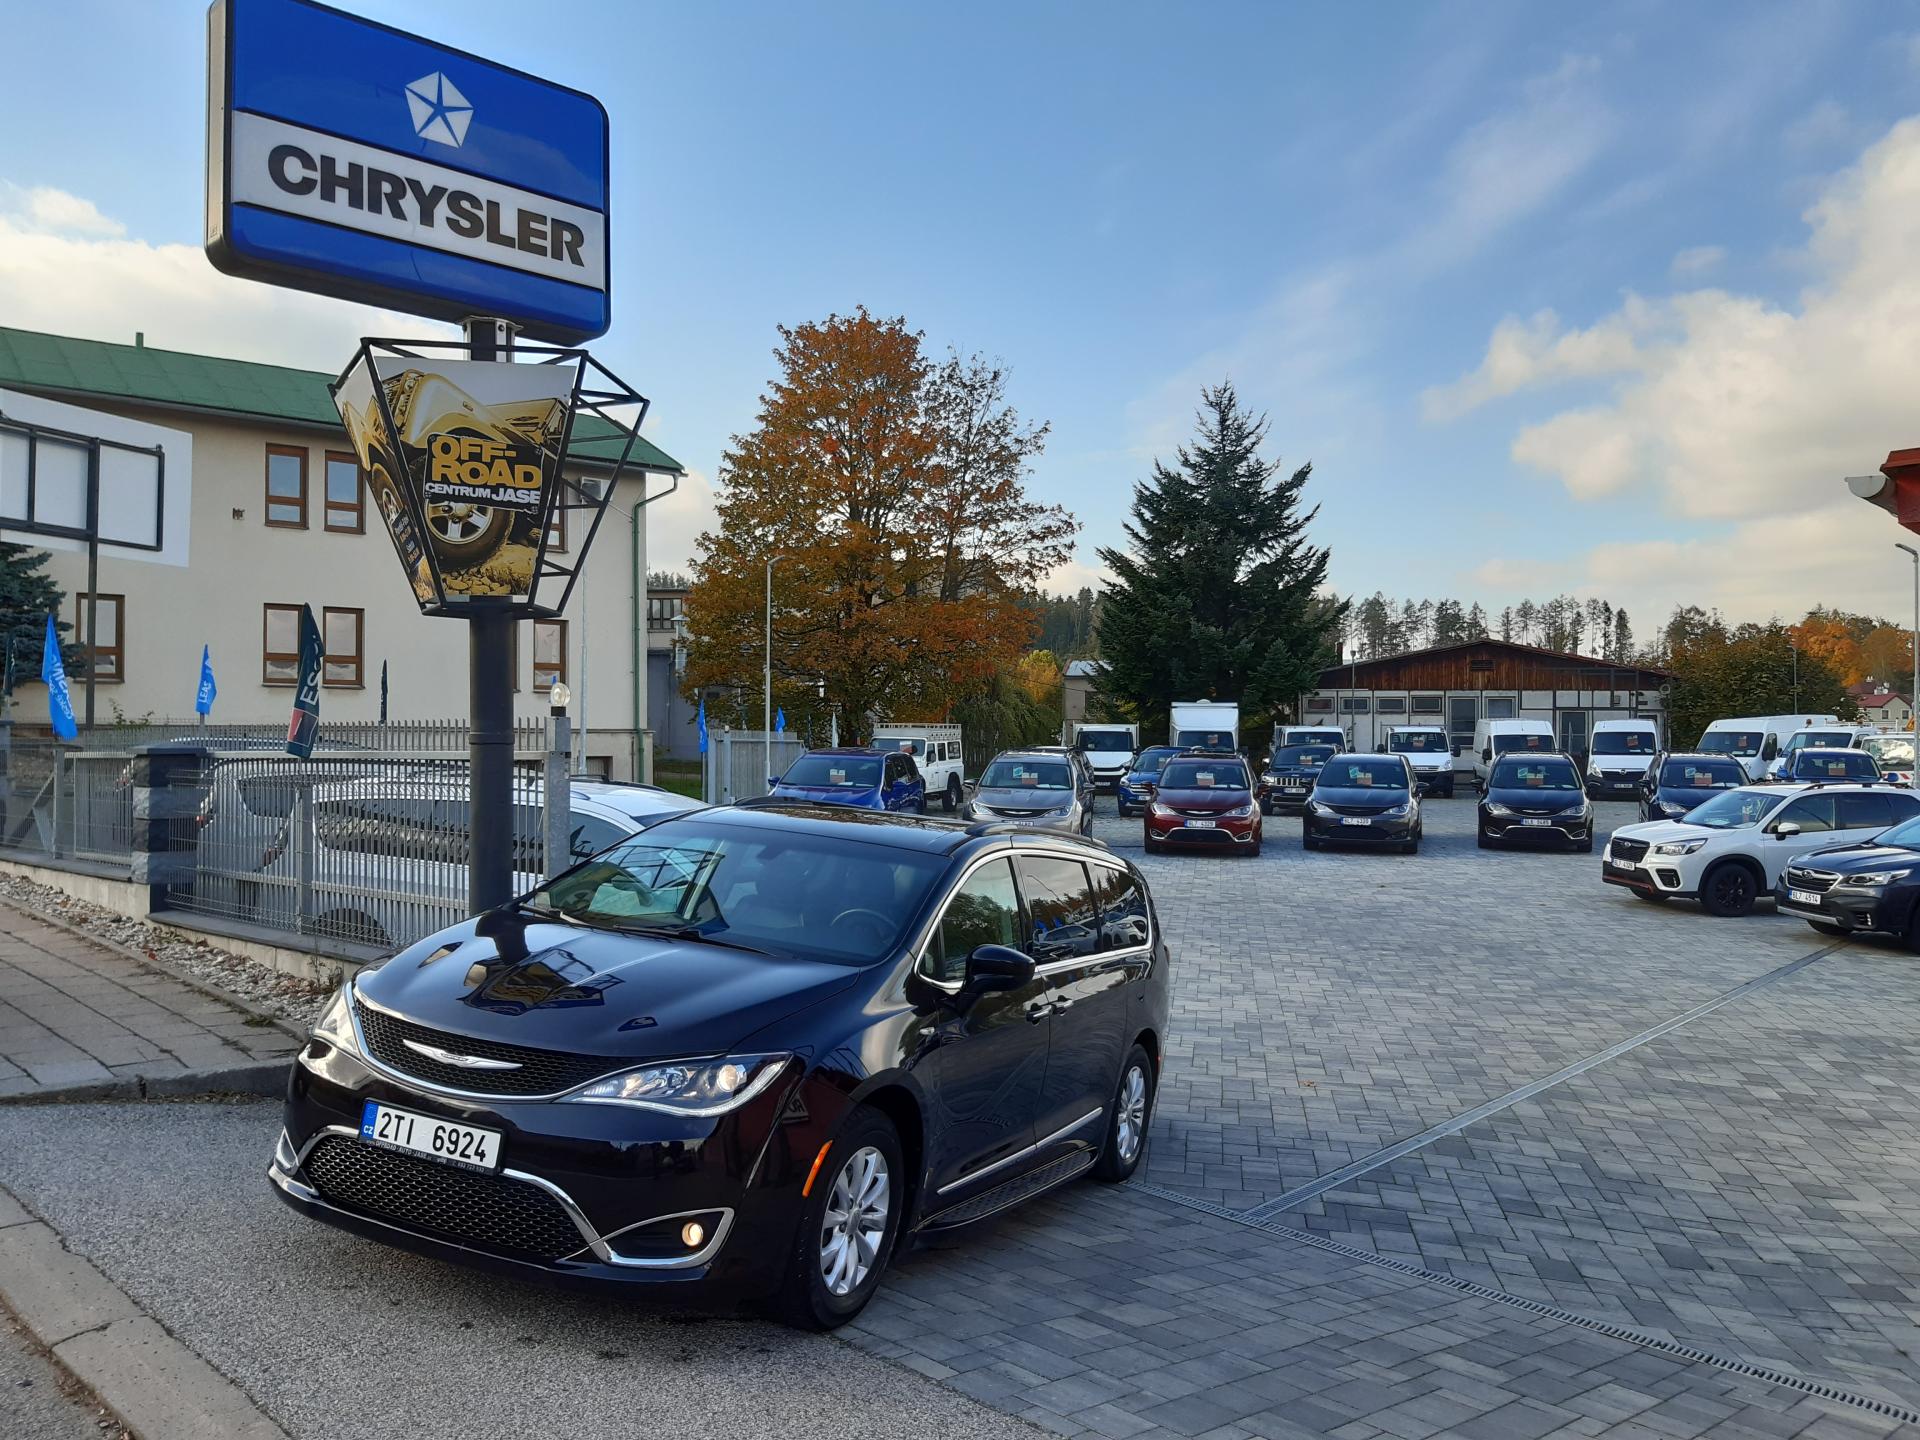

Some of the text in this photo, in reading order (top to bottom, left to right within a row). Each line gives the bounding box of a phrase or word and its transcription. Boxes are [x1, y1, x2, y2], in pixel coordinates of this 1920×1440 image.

[267, 144, 585, 267] CHRYSLER
[432, 435, 517, 462] OFF-
[432, 458, 542, 489] ROAD
[425, 483, 540, 504] CENTRUM JASE
[1805, 893, 1818, 903] 4514
[363, 1125, 373, 1135] CZ
[378, 1112, 486, 1162] 2TI 6924
